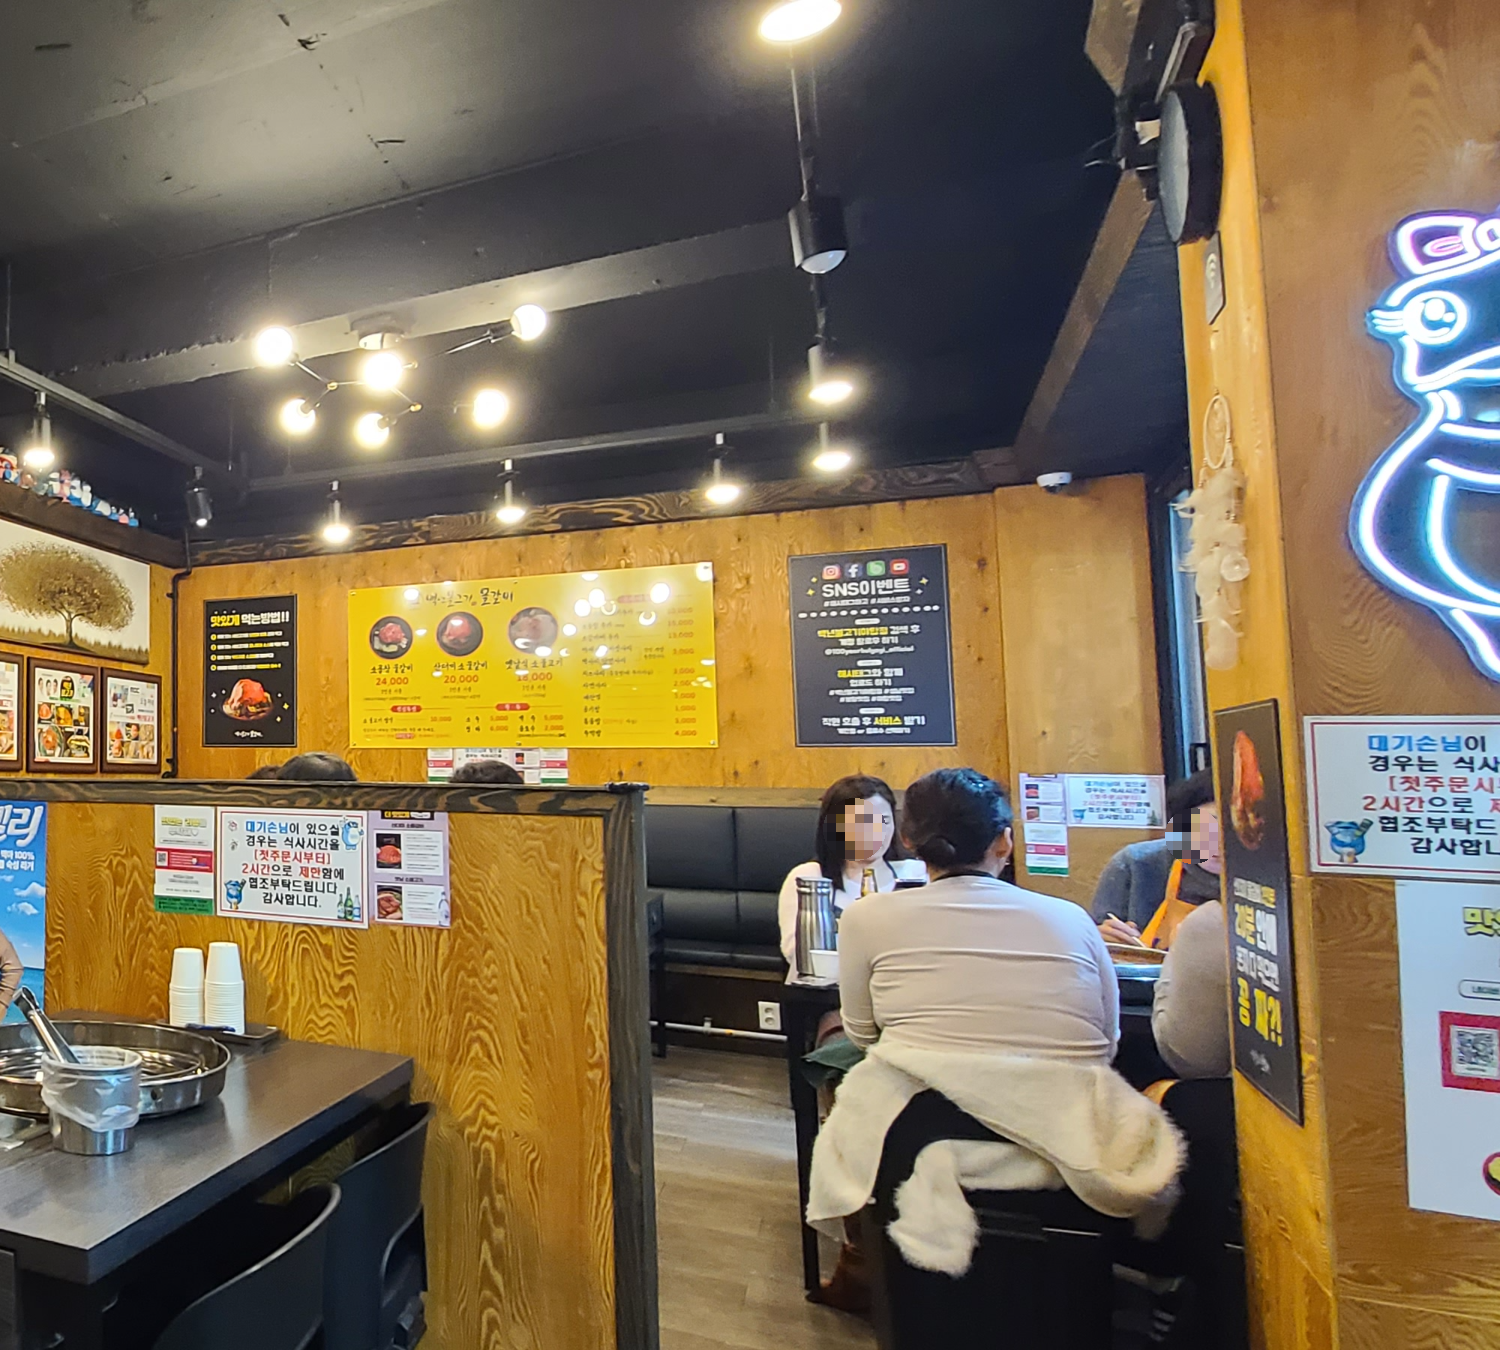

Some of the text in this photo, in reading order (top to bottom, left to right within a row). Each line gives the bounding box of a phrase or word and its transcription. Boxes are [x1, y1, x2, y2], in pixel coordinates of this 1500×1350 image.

[822, 578, 911, 597] SNS이벤트
[480, 588, 513, 606] 물갈비
[209, 614, 240, 627] 맛있게
[910, 625, 920, 634] 후
[458, 663, 465, 671] 소
[531, 660, 539, 668] 소
[376, 677, 409, 686] 24,000
[444, 674, 479, 684] 20,000
[862, 717, 871, 726] 후
[874, 716, 902, 725] 서비스
[1368, 734, 1487, 752] 대기손님이
[1368, 755, 1438, 773] 경우는
[1389, 776, 1500, 793] [첫주문시
[1363, 795, 1474, 813] 2시간으로
[246, 821, 340, 836] 대기손님이 있으실
[1379, 816, 1498, 835] 협조부탁드
[246, 835, 340, 850] 경우는 식사시간을
[15, 851, 35, 860] 100%
[254, 849, 331, 864] [첫주문시부터]
[242, 863, 344, 880] 2시간으로 제한함에
[249, 877, 337, 894] 협조부탁드립니다
[263, 892, 321, 907] 감사합니다.
